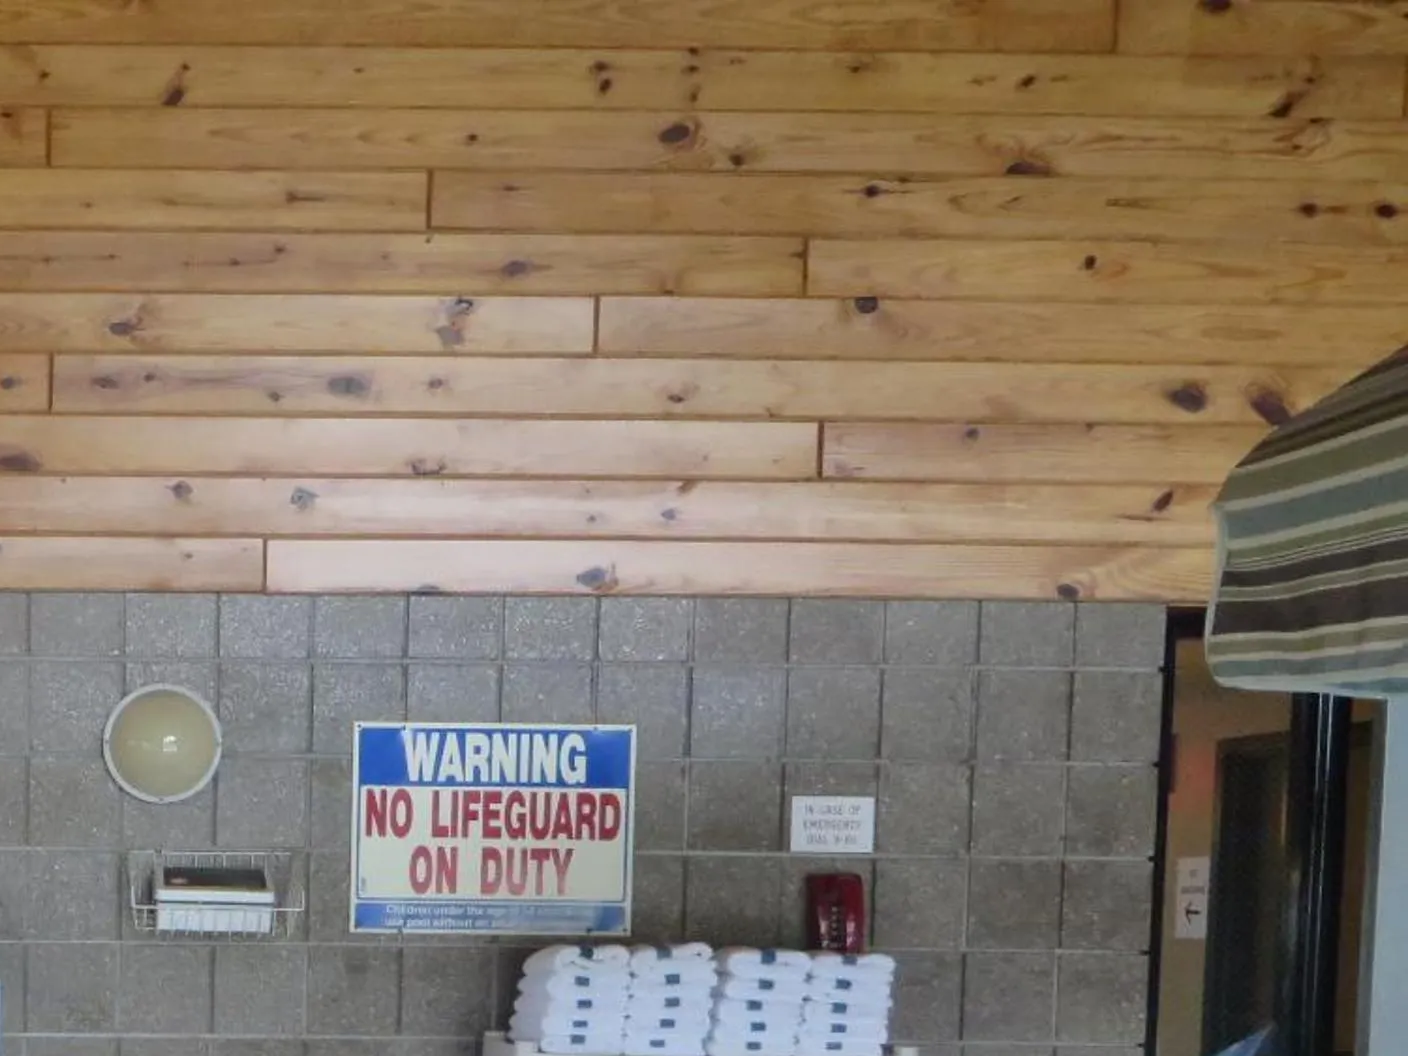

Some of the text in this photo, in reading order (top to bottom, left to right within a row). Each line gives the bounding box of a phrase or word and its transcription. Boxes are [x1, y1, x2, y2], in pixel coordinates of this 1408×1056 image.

[403, 731, 587, 784] WARNING
[365, 788, 621, 841] NO LIFEGUARD
[409, 845, 575, 896] ON DUTY
